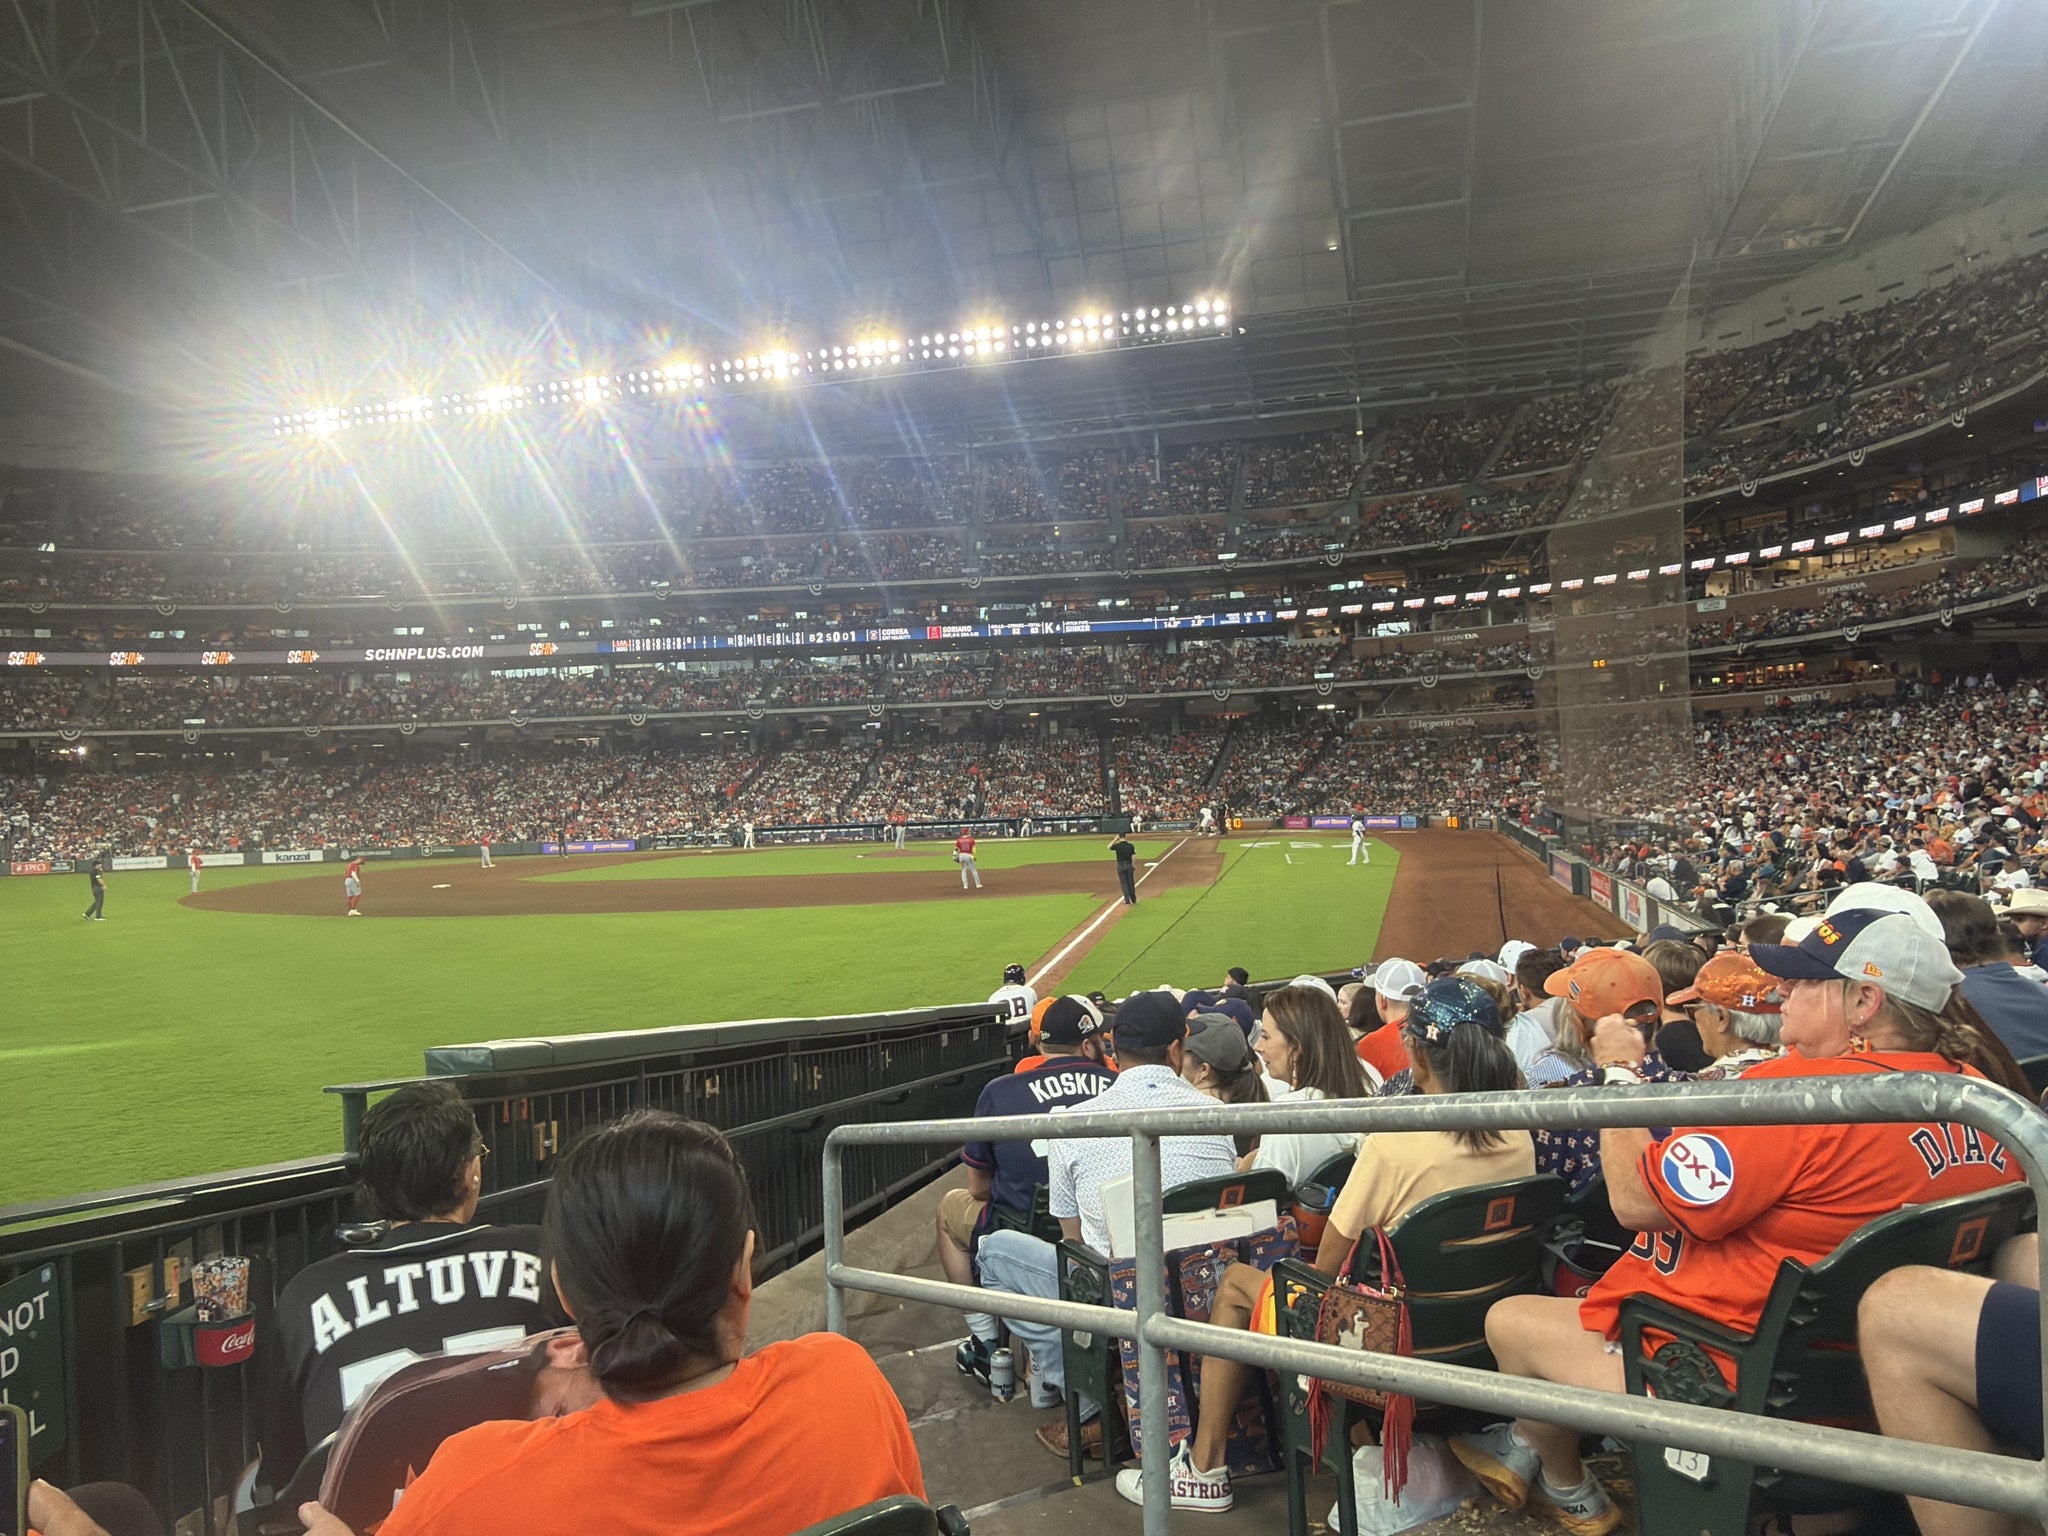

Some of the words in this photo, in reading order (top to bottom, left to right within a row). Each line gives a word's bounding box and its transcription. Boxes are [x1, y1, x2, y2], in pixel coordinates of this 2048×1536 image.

[1827, 582, 1867, 594] HONDA
[882, 628, 909, 636] CORREA
[1045, 622, 1054, 634] K
[1065, 625, 1090, 633] SINKER
[728, 637, 734, 645] R
[816, 633, 824, 643] 2
[826, 633, 832, 641] S
[833, 631, 840, 642] 0
[850, 631, 856, 642] 1
[1443, 633, 1479, 642] HONDA
[365, 646, 484, 661] SCHNPLUS.COM
[1670, 1141, 1728, 1191] OXY
[310, 1250, 542, 1355] ALTUVE
[1675, 1450, 1698, 1471] 13
[1170, 1482, 1231, 1499] ASTROS
